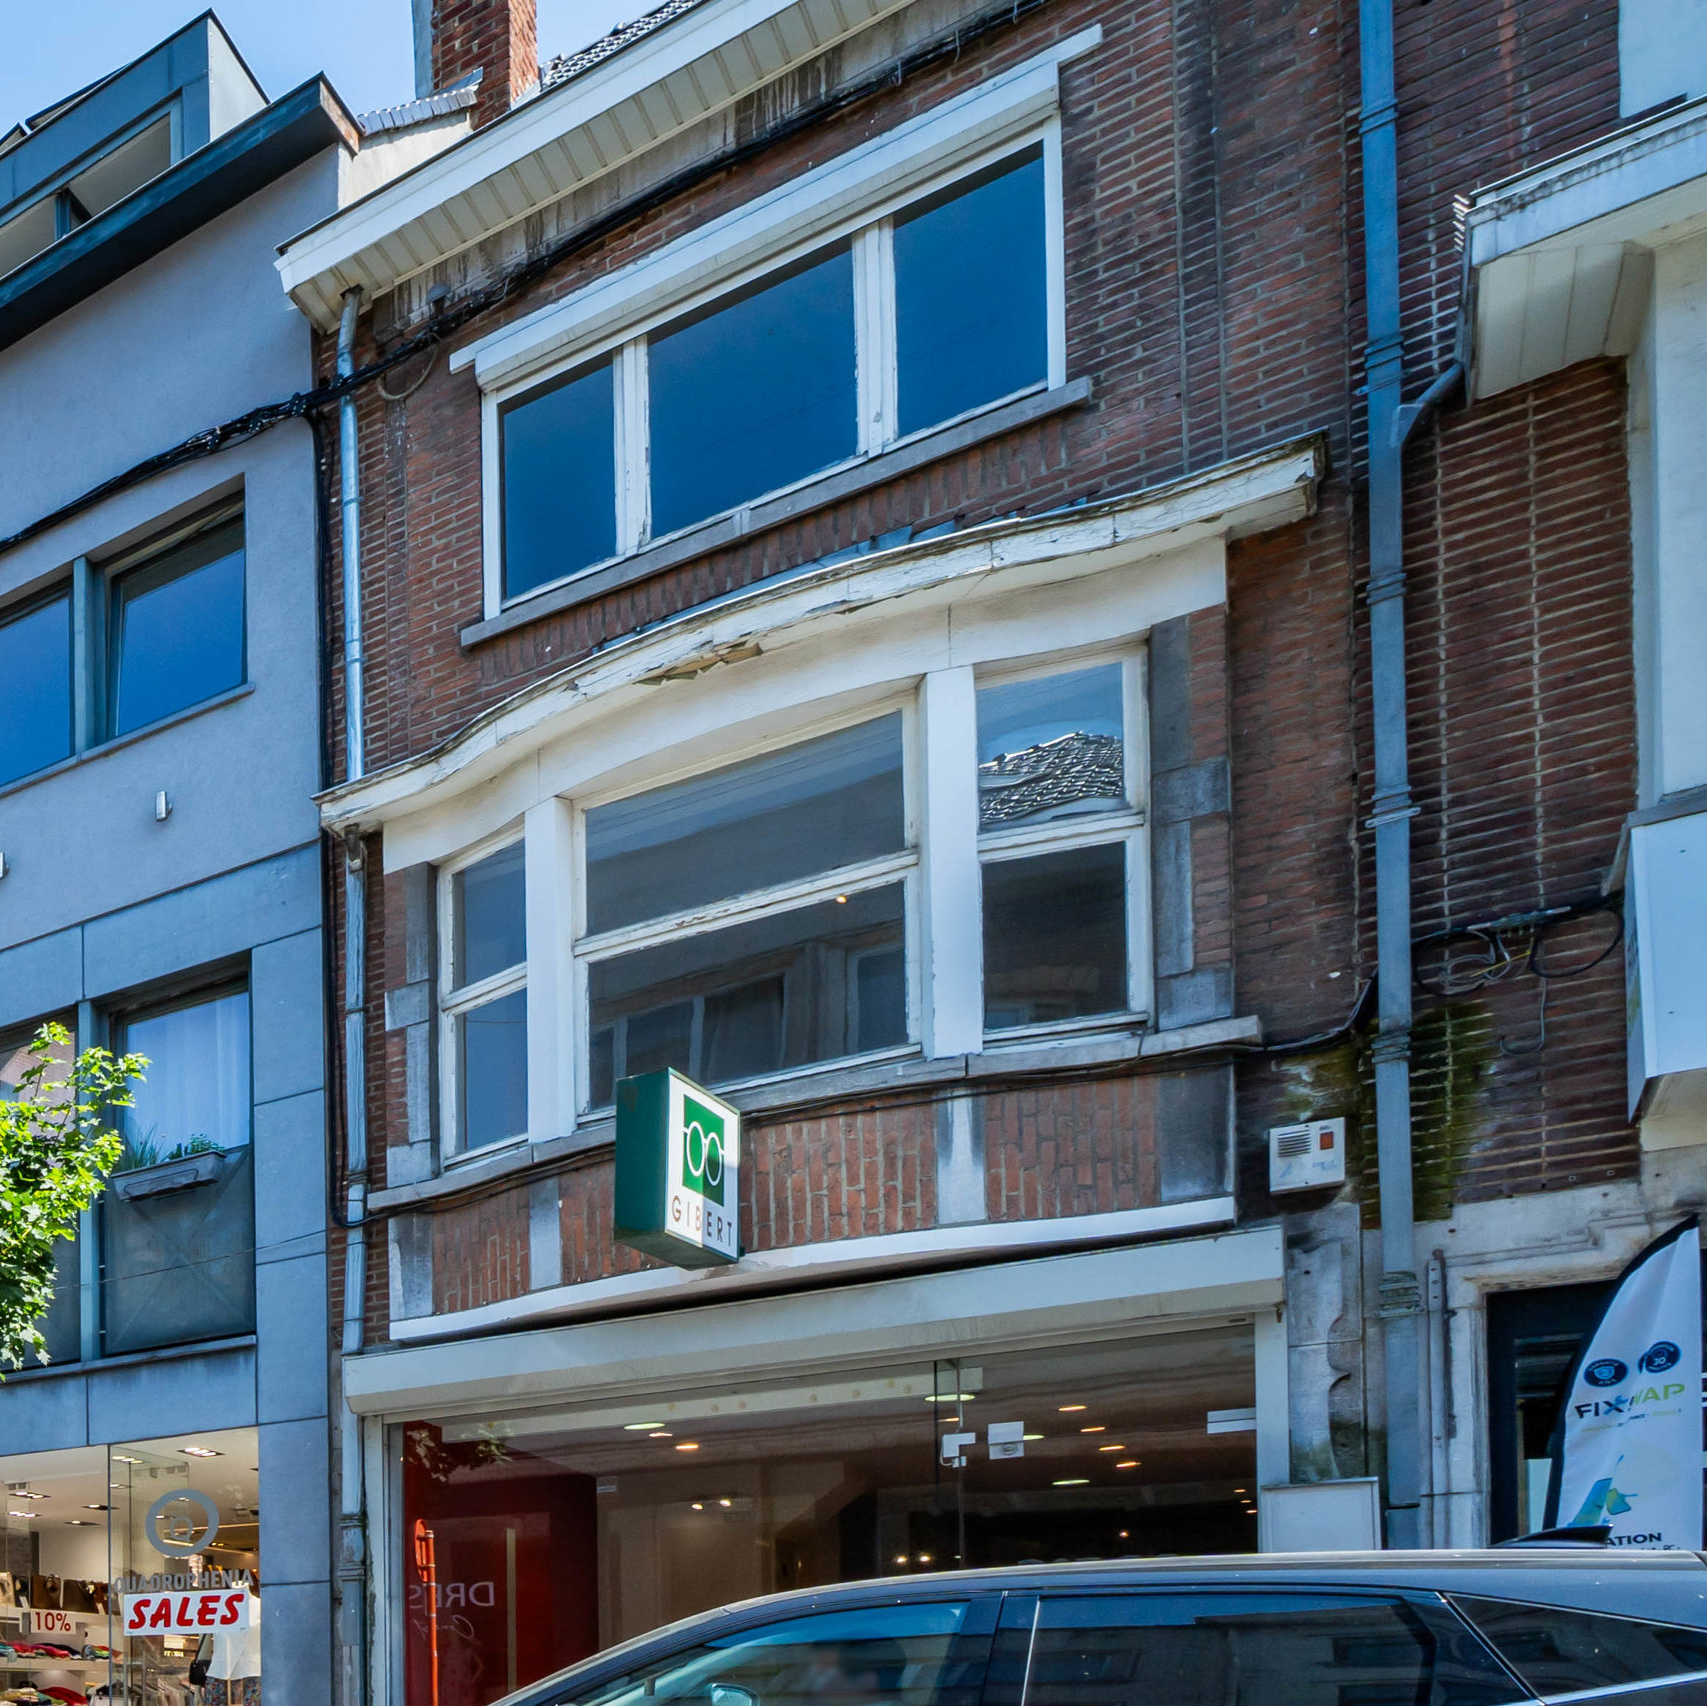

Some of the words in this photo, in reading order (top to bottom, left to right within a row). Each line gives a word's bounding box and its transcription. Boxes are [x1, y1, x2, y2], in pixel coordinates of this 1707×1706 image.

[671, 1194, 733, 1247] GIBERT
[114, 1568, 254, 1595] QUADROPHENIA
[34, 1611, 72, 1632] 10%
[128, 1593, 245, 1630] SALES
